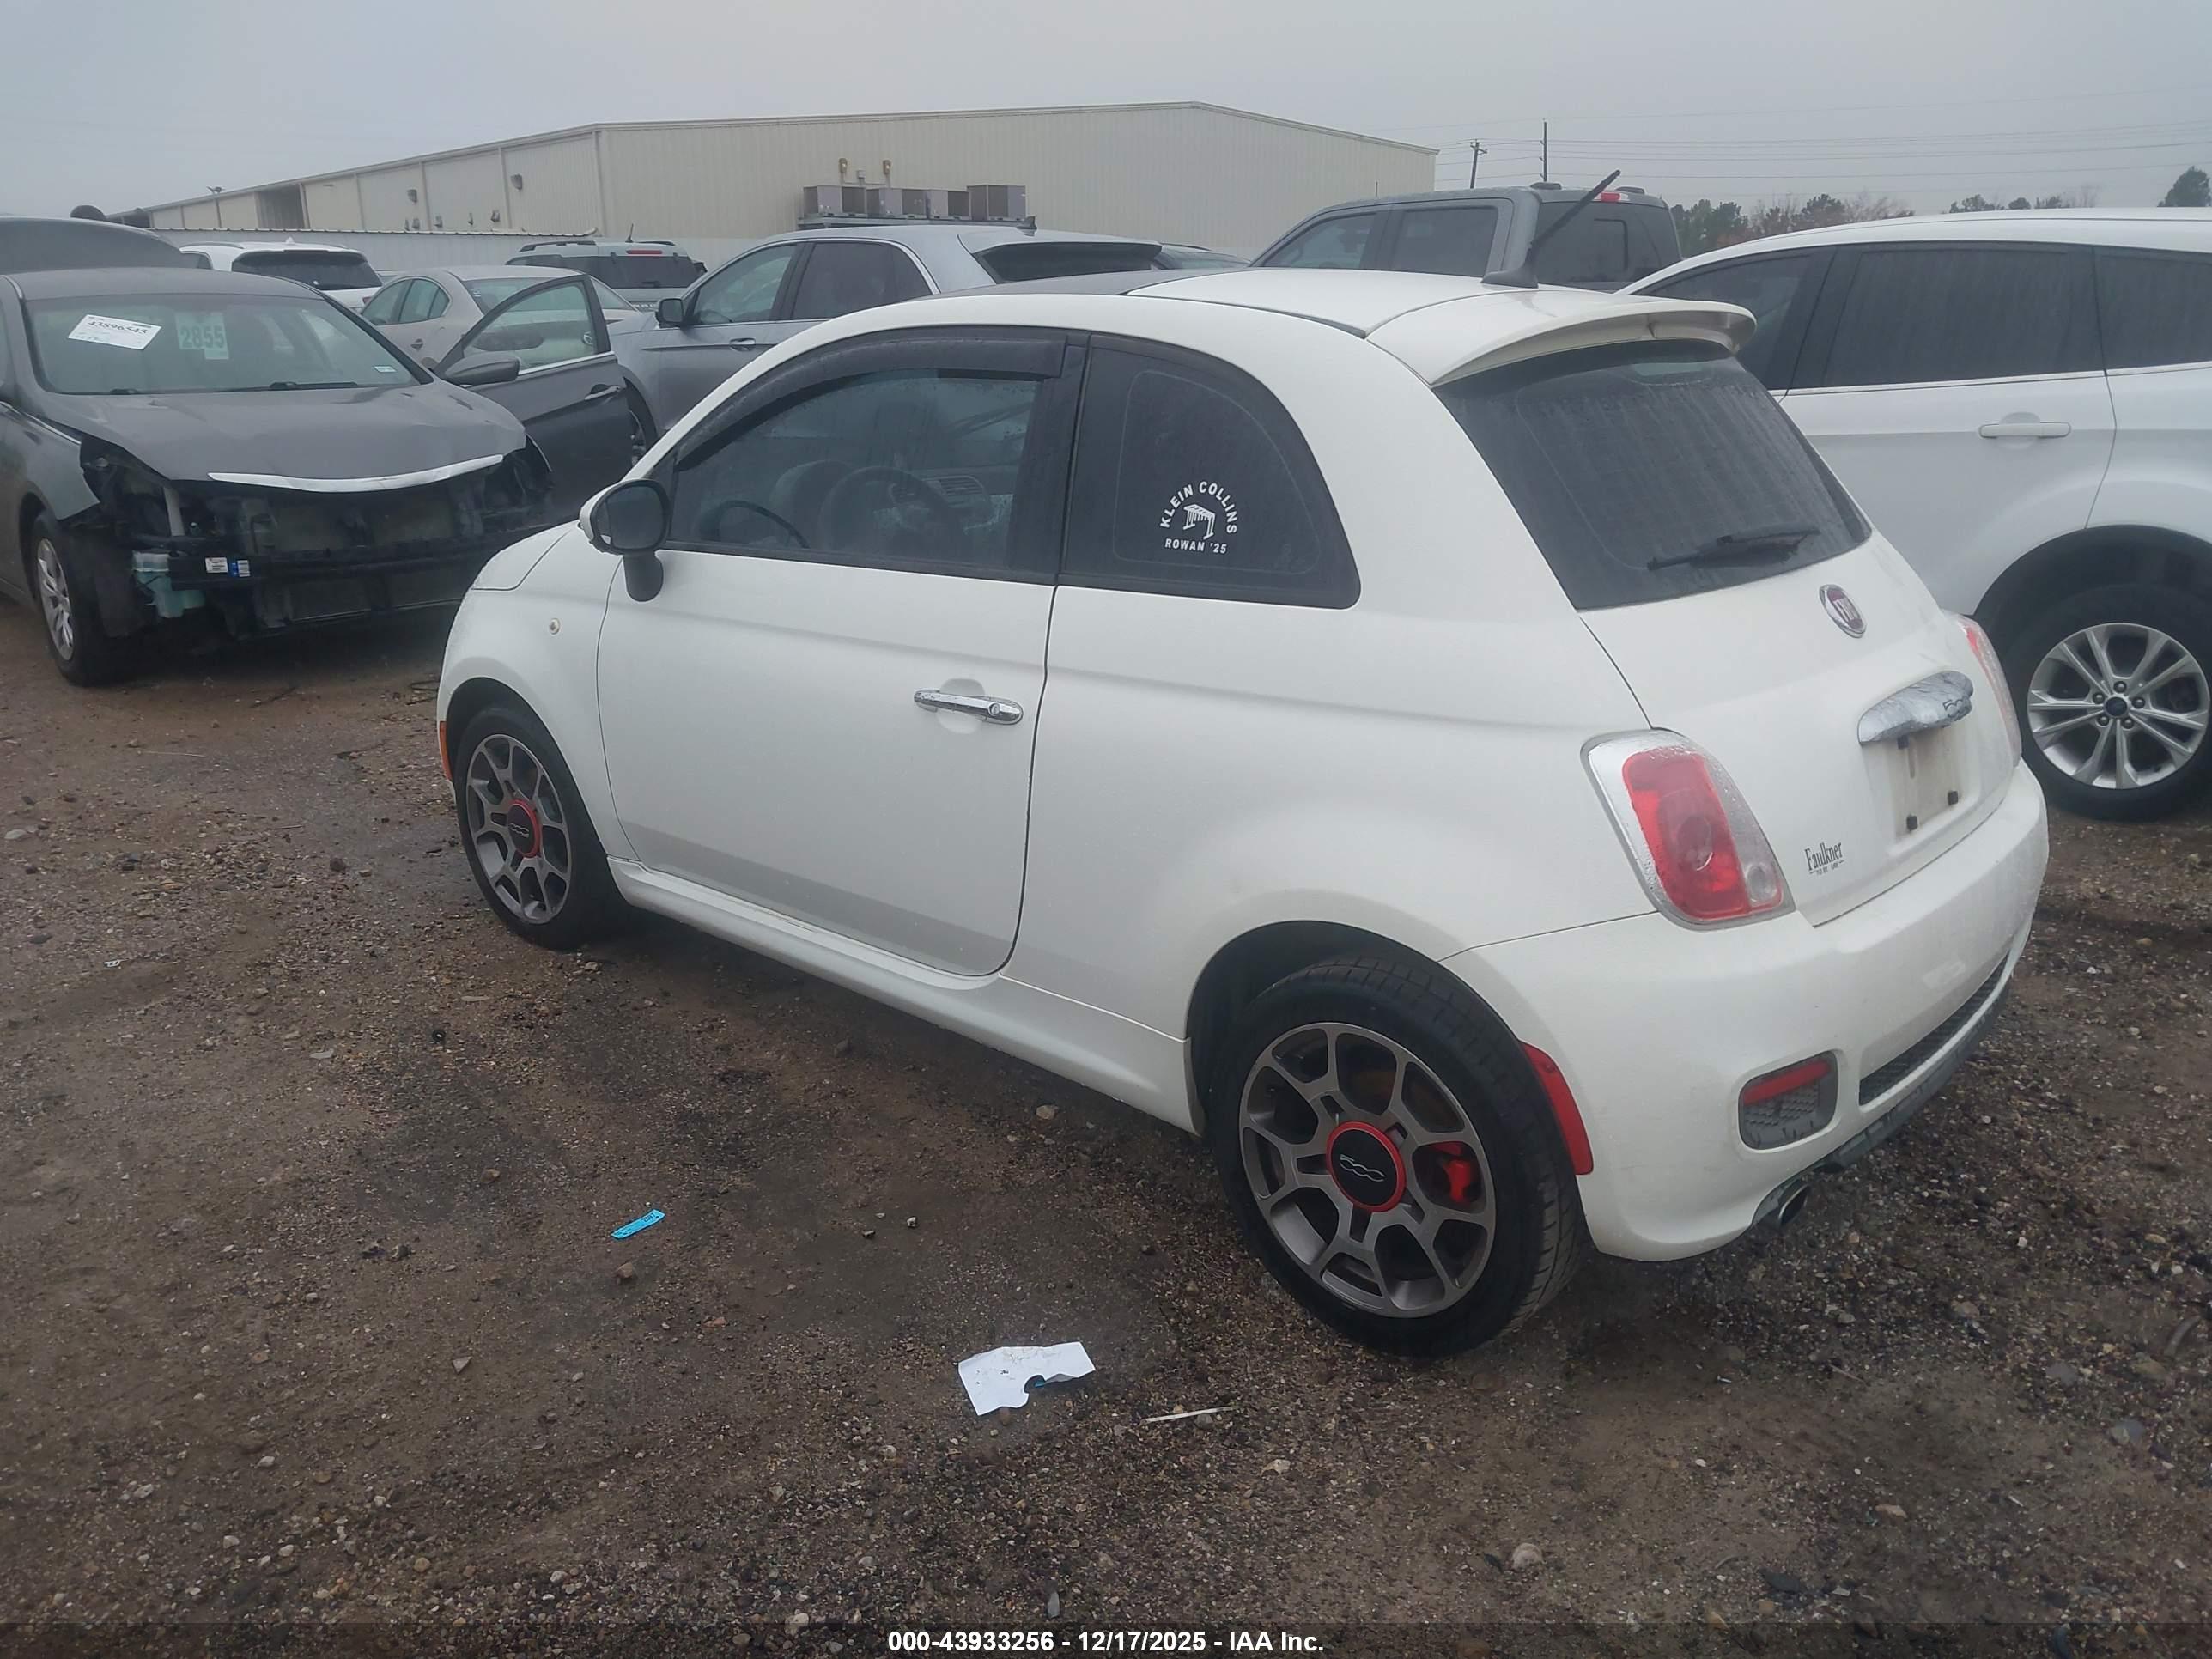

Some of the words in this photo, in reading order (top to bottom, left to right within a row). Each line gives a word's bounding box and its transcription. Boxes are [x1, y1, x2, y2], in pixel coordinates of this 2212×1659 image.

[179, 325, 225, 349] 2855
[1159, 483, 1194, 528] KLEIN
[1199, 481, 1237, 533] COLLINS
[1164, 538, 1205, 551] ROWAN
[1209, 542, 1227, 554] '25
[1804, 842, 1843, 871] Faulkner
[1339, 1153, 1386, 1182] 500
